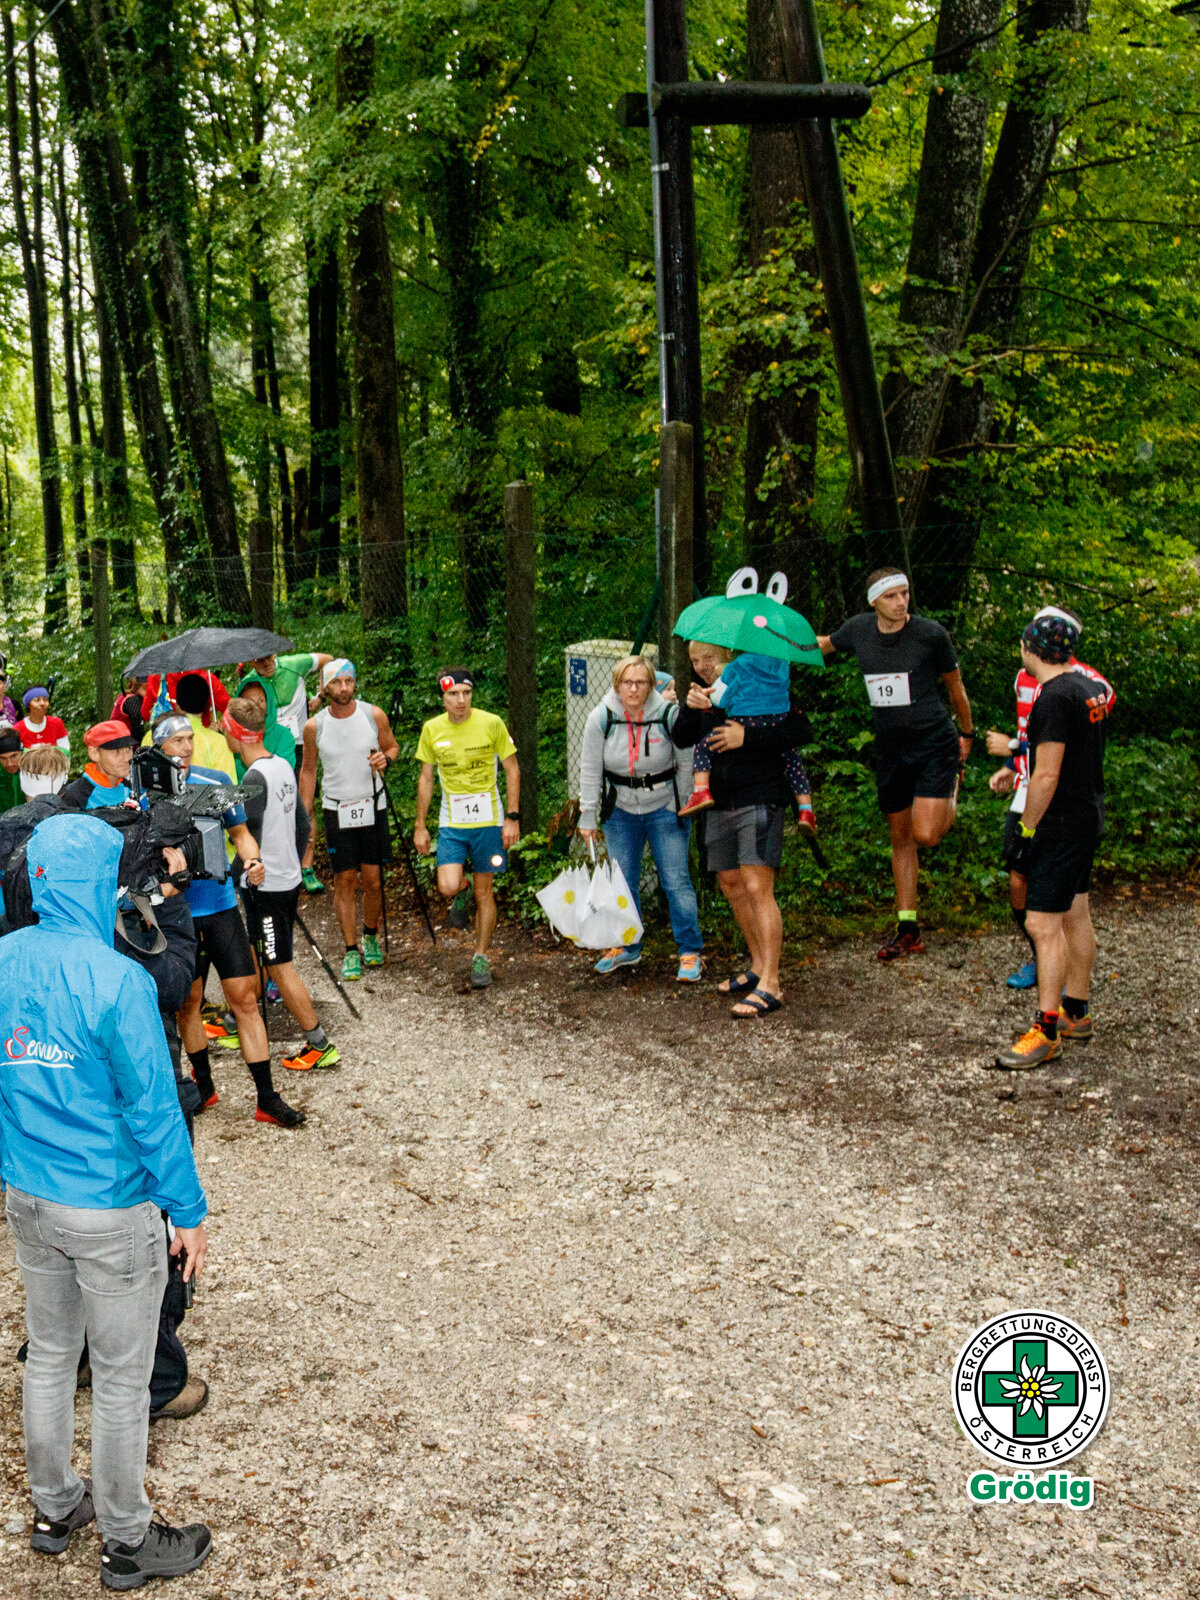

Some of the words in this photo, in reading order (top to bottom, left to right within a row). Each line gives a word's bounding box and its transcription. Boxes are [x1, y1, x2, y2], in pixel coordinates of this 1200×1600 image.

[877, 685, 894, 697] 19
[351, 808, 365, 819] 87
[465, 803, 480, 815] 14
[263, 916, 276, 960] skinfit
[4, 1026, 62, 1062] Servus
